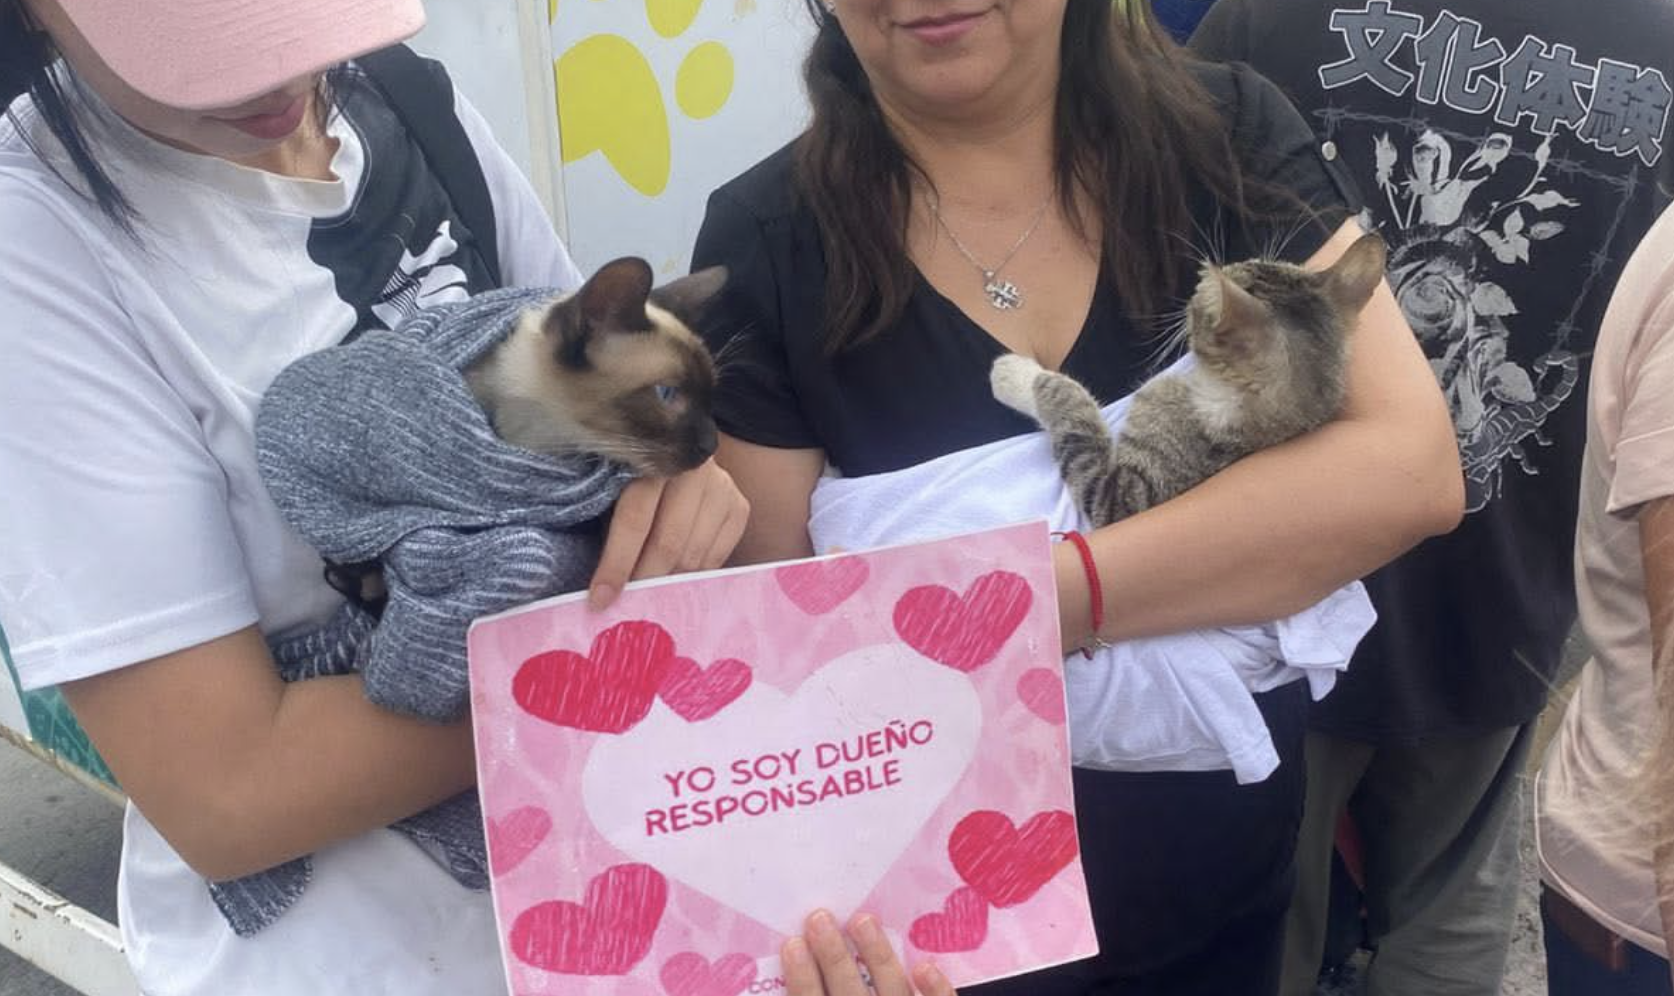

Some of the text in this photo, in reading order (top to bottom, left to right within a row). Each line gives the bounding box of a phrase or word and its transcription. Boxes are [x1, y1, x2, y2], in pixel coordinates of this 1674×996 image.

[1319, 0, 1673, 166] 文化体験
[664, 720, 934, 797] YO SOY DUEÑO
[646, 760, 902, 837] RESPONSABLE
